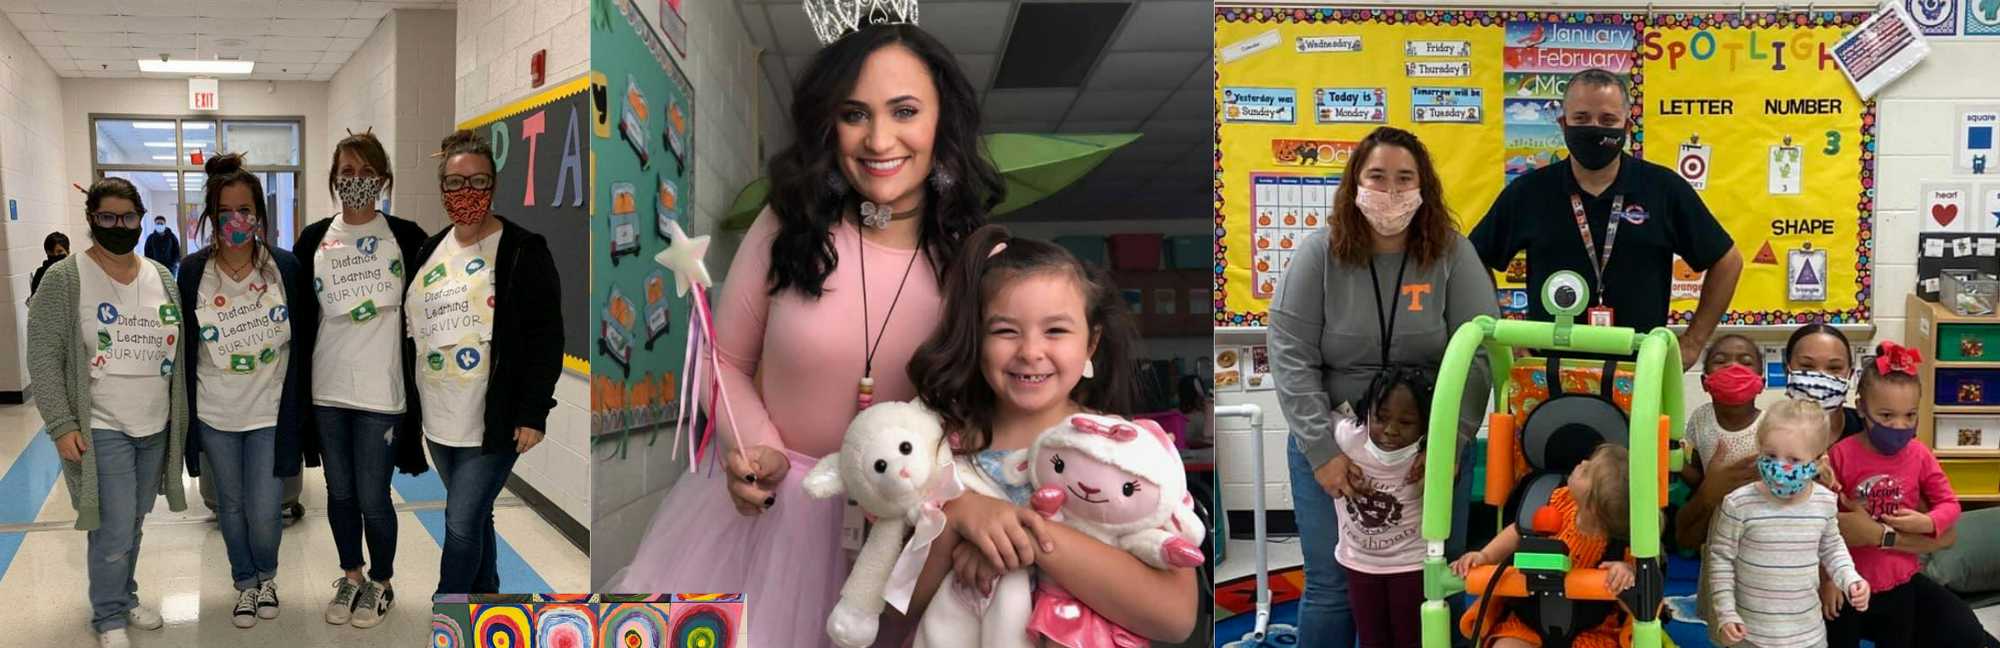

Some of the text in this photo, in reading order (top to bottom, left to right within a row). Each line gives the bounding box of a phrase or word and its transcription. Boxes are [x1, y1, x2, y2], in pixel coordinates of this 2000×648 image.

[1550, 24, 1631, 48] January
[1305, 39, 1353, 50] Wednesday
[1426, 43, 1456, 55] Friday
[1643, 31, 1846, 71] SPOTLIGH
[1537, 50, 1628, 71] February
[1419, 64, 1459, 76] Thursday
[194, 92, 214, 109] EXIT
[1233, 94, 1274, 106] Yesterday
[1329, 91, 1372, 106] Today is
[1413, 88, 1481, 97] Tomorrow will be
[1242, 106, 1274, 118] Sunday
[1335, 108, 1370, 119] Monday
[1429, 108, 1466, 120] Tuesday
[1660, 100, 1734, 115] LETTER
[1765, 99, 1841, 114] NUMBER
[1967, 114, 1996, 122] square
[1823, 131, 1841, 155] 3
[1936, 191, 1958, 199] heart
[1771, 219, 1834, 235] SHAPE
[332, 255, 377, 270] Distance
[332, 268, 381, 286] Learning
[327, 281, 394, 304] SURVIVOR
[425, 285, 467, 302] Distance
[1402, 284, 1431, 311] T
[217, 303, 263, 321] Distance
[425, 301, 469, 320] Learning
[117, 314, 161, 328] Distance
[221, 315, 270, 338] Learning
[420, 315, 482, 337] SURVIVOR
[116, 330, 163, 348] Learning
[218, 326, 283, 356] SURVIVOR
